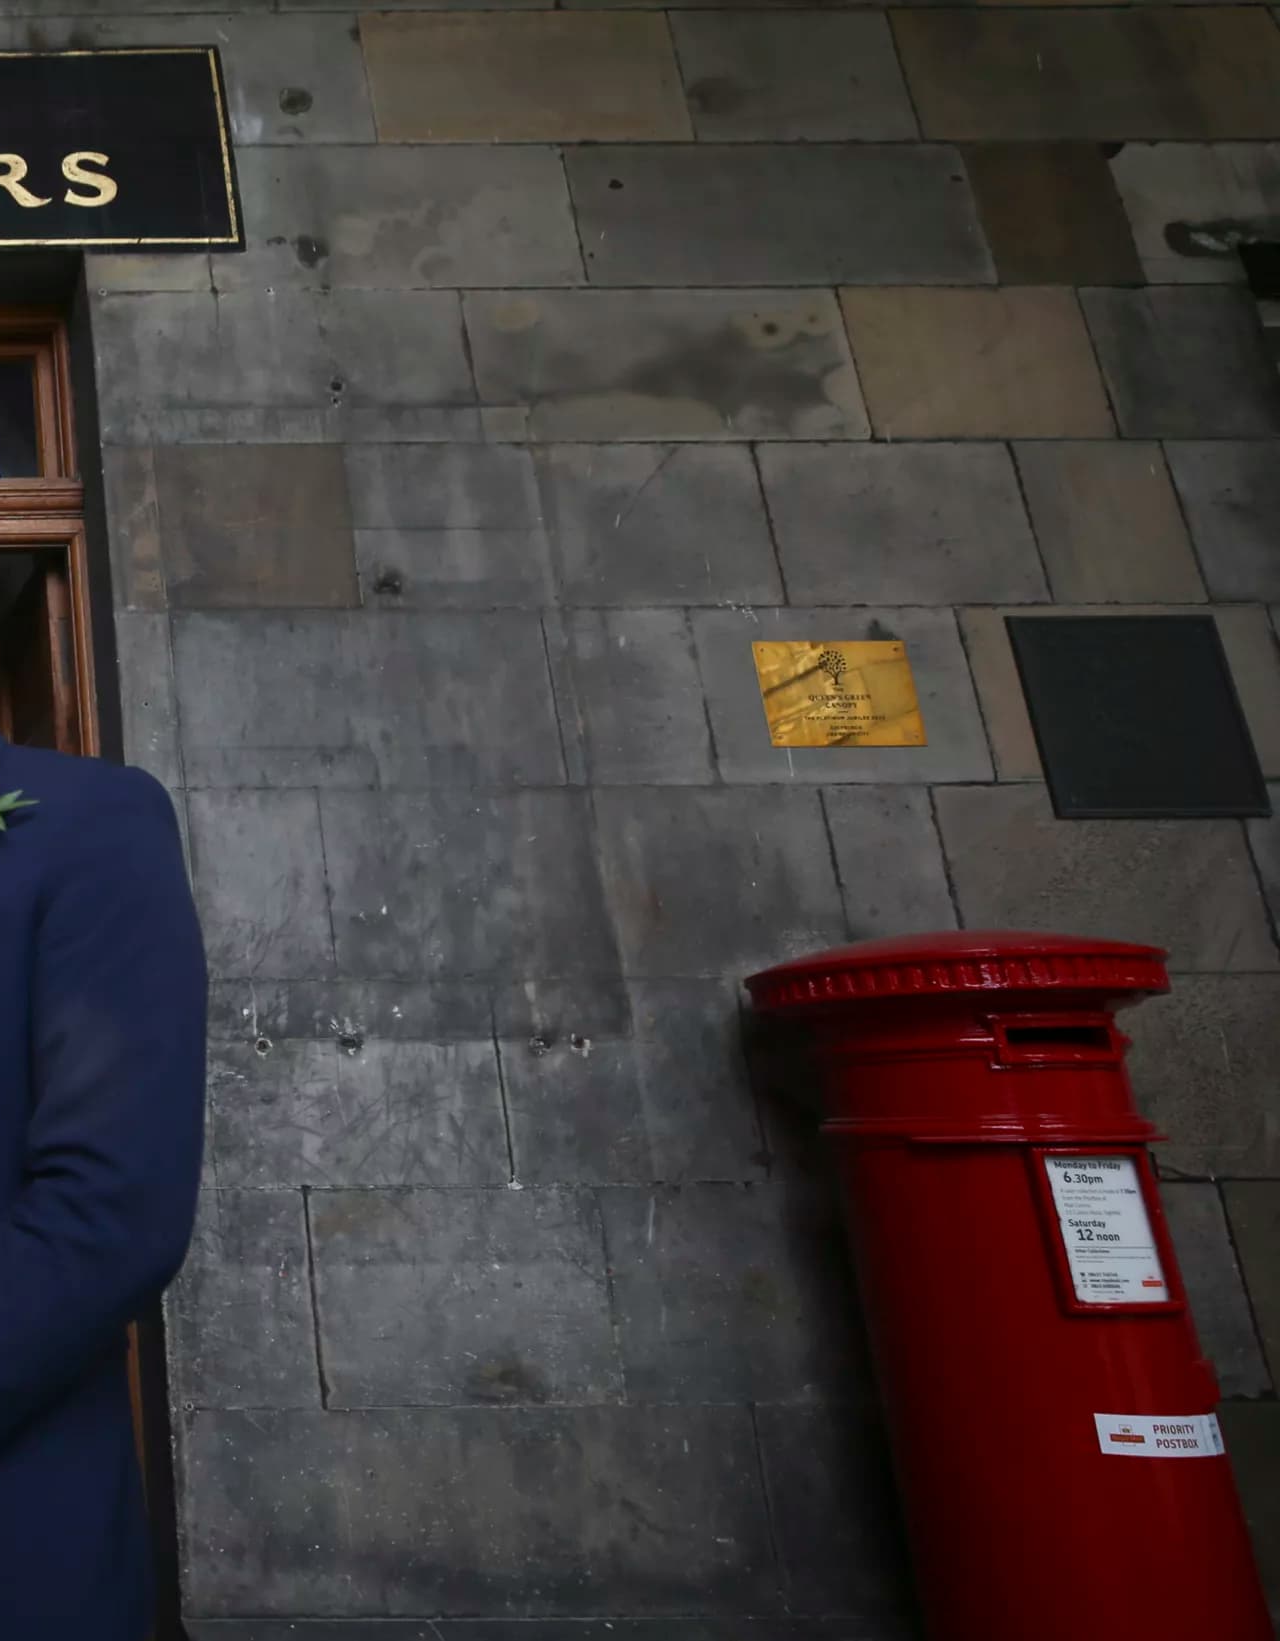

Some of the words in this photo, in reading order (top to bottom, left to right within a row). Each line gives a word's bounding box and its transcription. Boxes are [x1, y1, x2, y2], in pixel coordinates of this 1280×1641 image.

[1054, 1160, 1087, 1171] Monday
[1088, 1161, 1097, 1170] to
[1098, 1160, 1121, 1171] Friday
[1063, 1171, 1104, 1185] 6.30pm
[1068, 1219, 1106, 1229] Saturday
[1076, 1229, 1094, 1241] 12
[1096, 1232, 1121, 1241] noon
[1152, 1424, 1195, 1435] PRIORITY
[1156, 1438, 1199, 1449] POSTBOX
